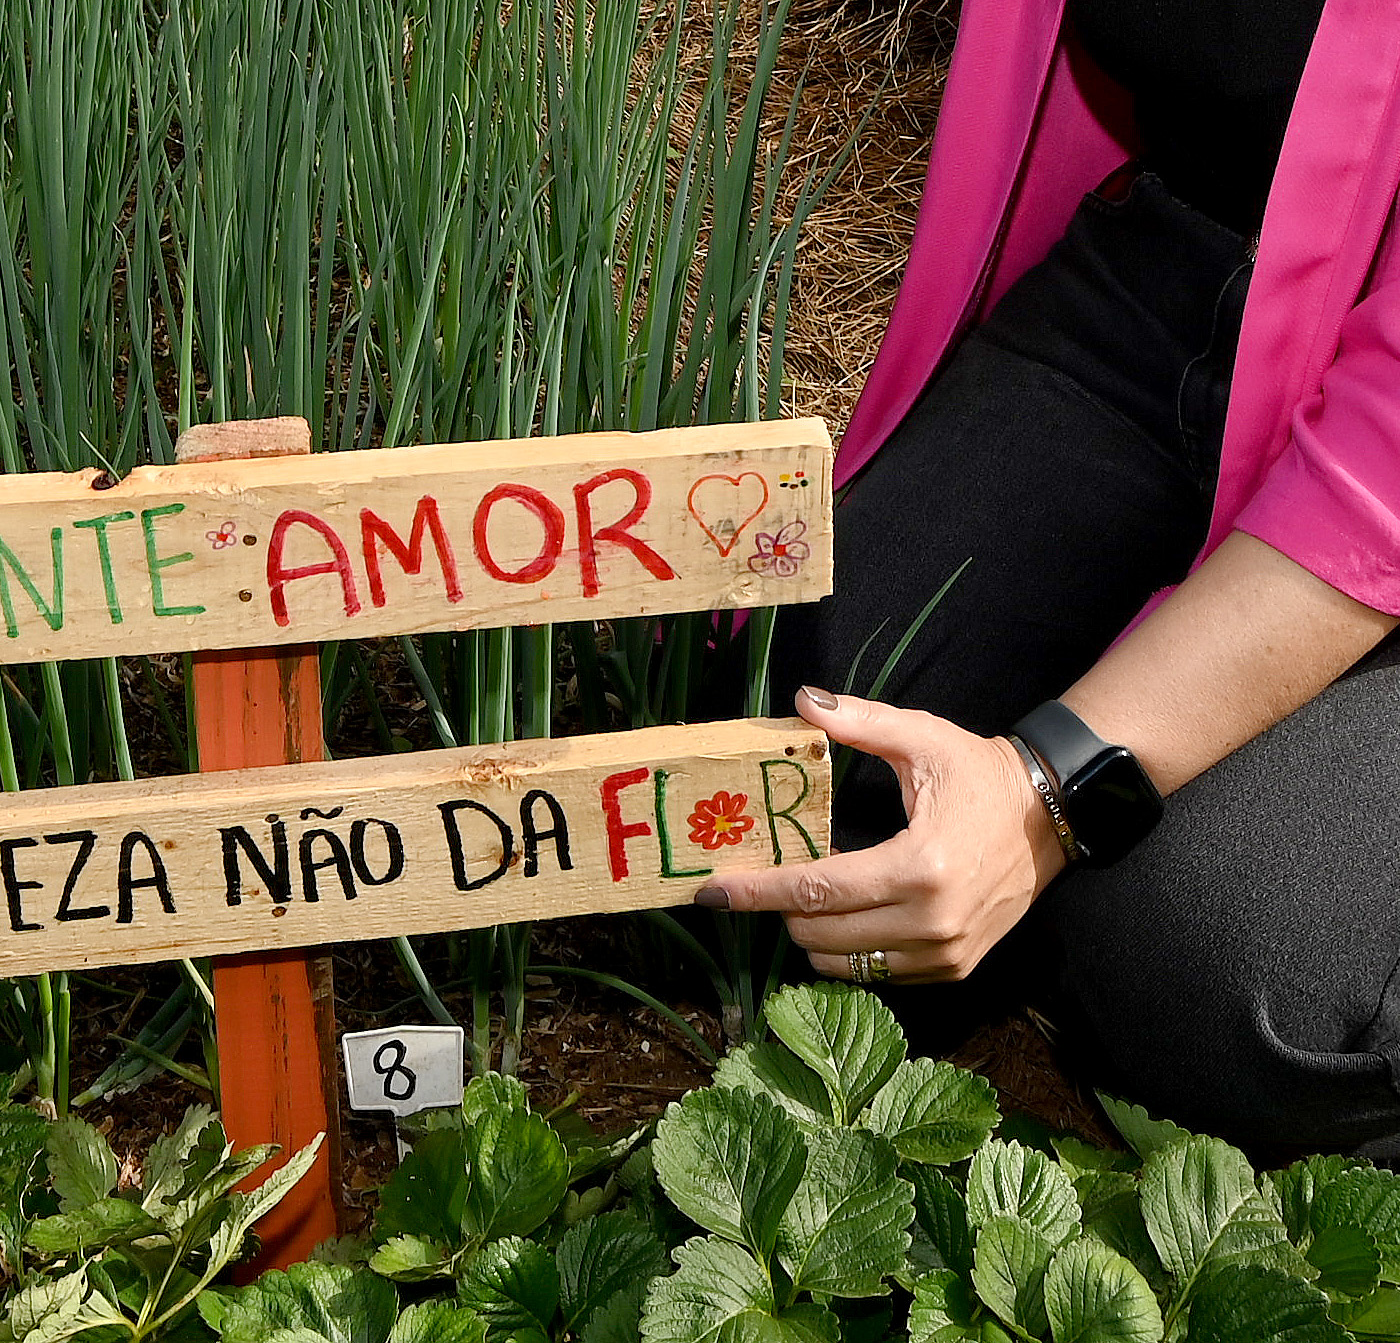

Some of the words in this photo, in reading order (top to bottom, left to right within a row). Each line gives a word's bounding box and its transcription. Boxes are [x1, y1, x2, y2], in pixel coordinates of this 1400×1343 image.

[266, 467, 677, 627] AMOR
[219, 805, 405, 907] NÃO
[438, 789, 575, 892] DA
[373, 1039, 417, 1101] 8
